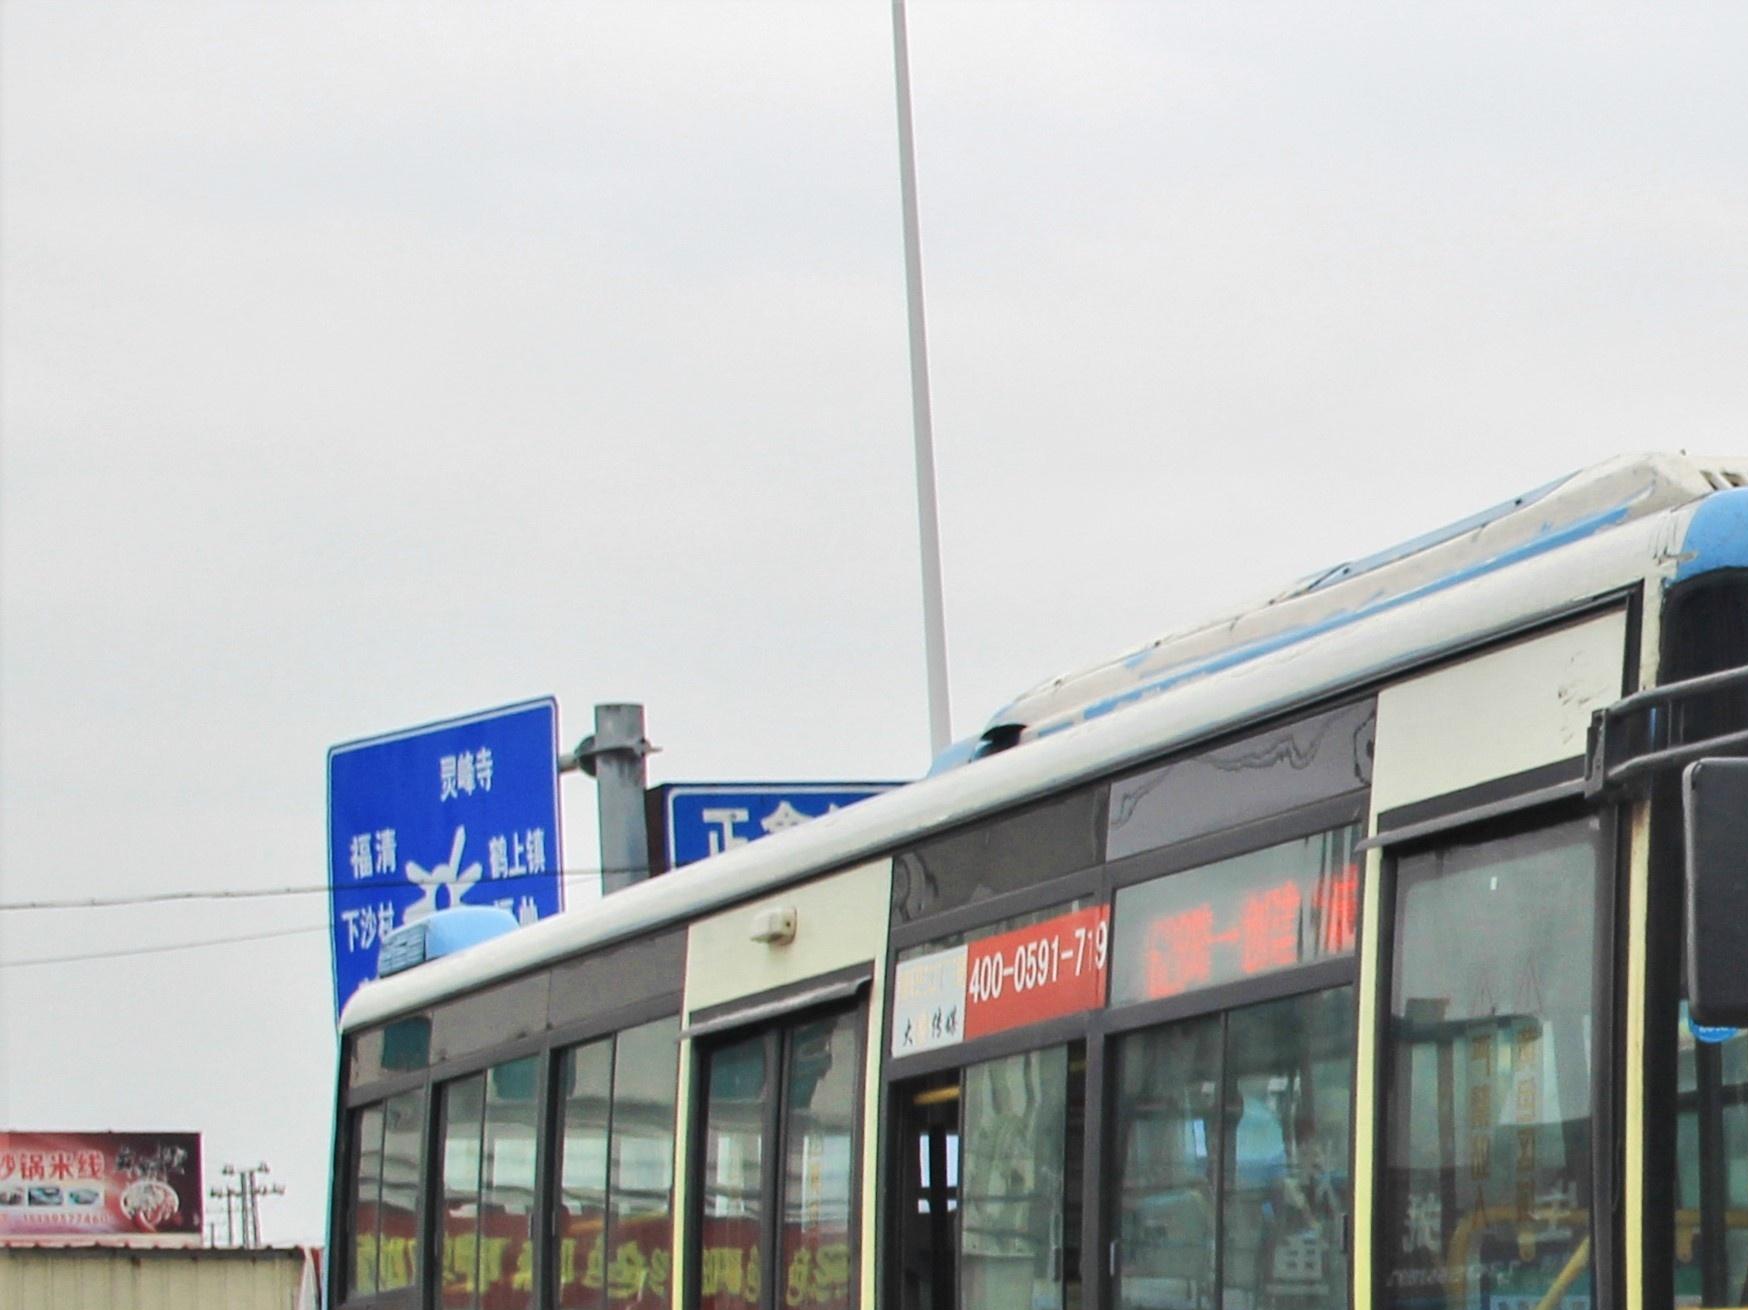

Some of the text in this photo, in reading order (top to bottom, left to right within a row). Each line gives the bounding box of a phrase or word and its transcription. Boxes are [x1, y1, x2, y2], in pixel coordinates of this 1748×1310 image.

[439, 748, 494, 802] 灵峰寺
[350, 828, 398, 881] 福清
[488, 828, 546, 881] 鹤上镇
